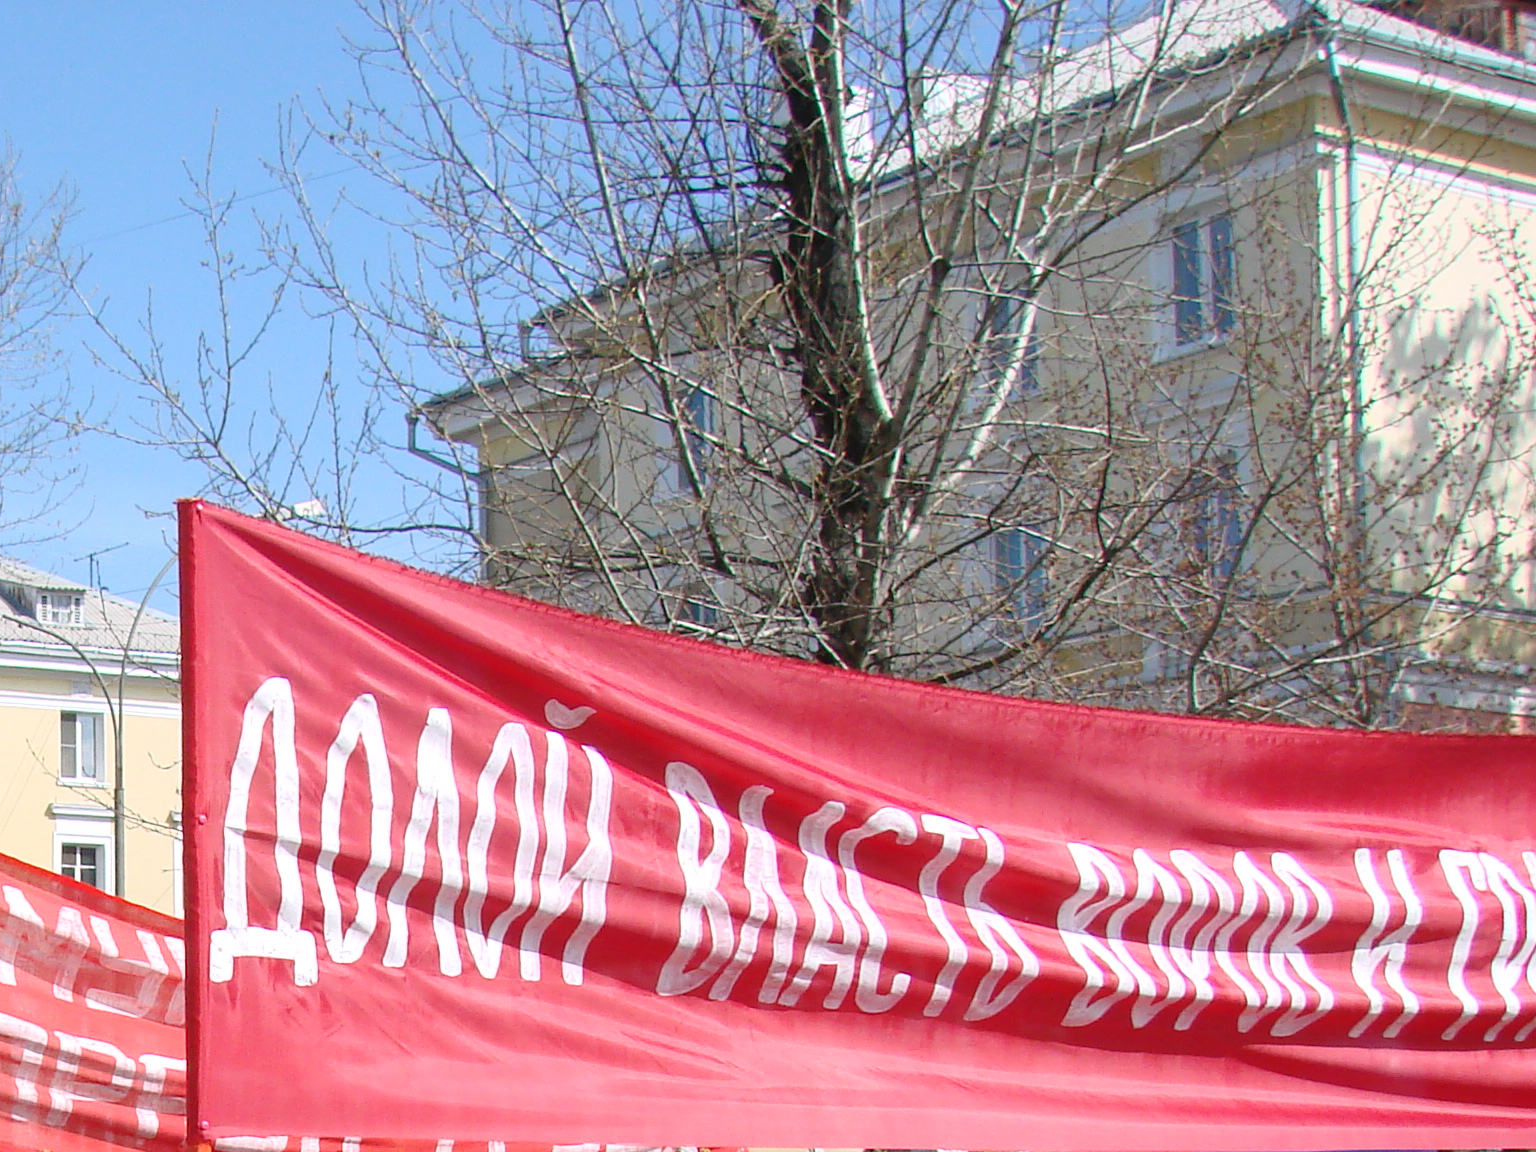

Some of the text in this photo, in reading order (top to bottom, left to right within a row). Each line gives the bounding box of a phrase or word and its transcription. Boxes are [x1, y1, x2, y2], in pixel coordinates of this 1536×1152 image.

[210, 676, 1536, 1043] ДОЛОЙ ВЛАСТЬ ВОРОВ И ГР
